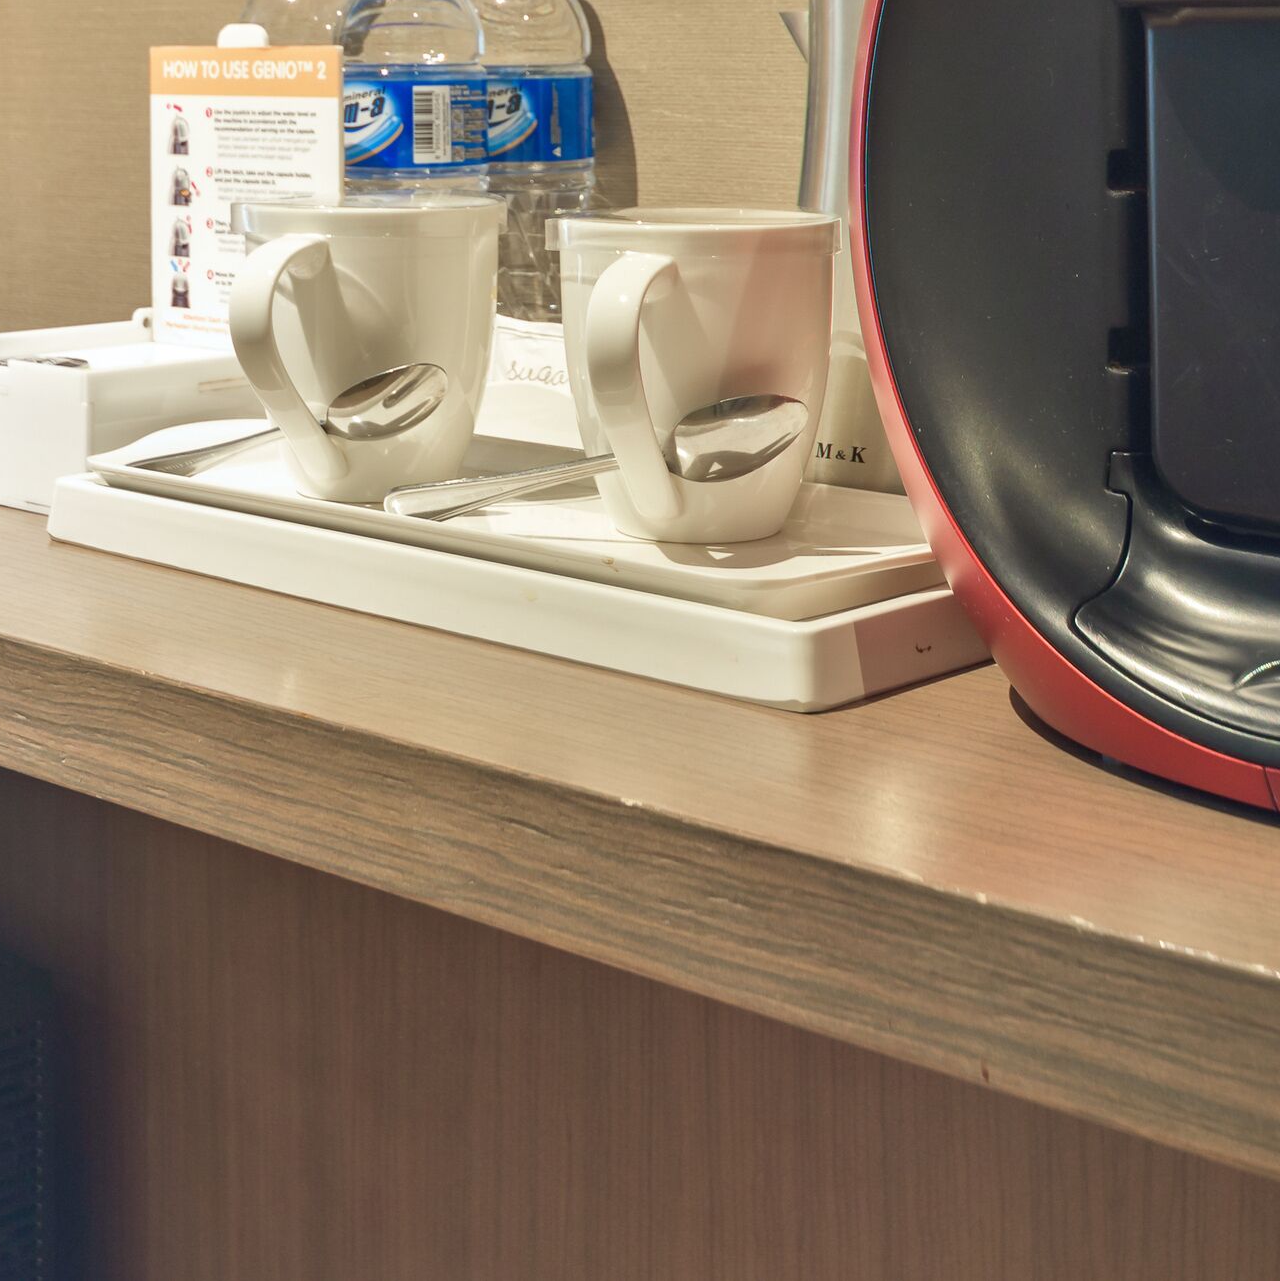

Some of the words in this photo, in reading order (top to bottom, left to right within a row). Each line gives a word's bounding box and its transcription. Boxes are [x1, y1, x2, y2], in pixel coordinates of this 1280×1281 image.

[163, 60, 198, 78] HOW
[200, 60, 220, 79] TO
[222, 60, 249, 79] USE
[317, 61, 327, 80] 2
[815, 442, 833, 459] M
[835, 449, 846, 460] &
[850, 446, 868, 464] K
